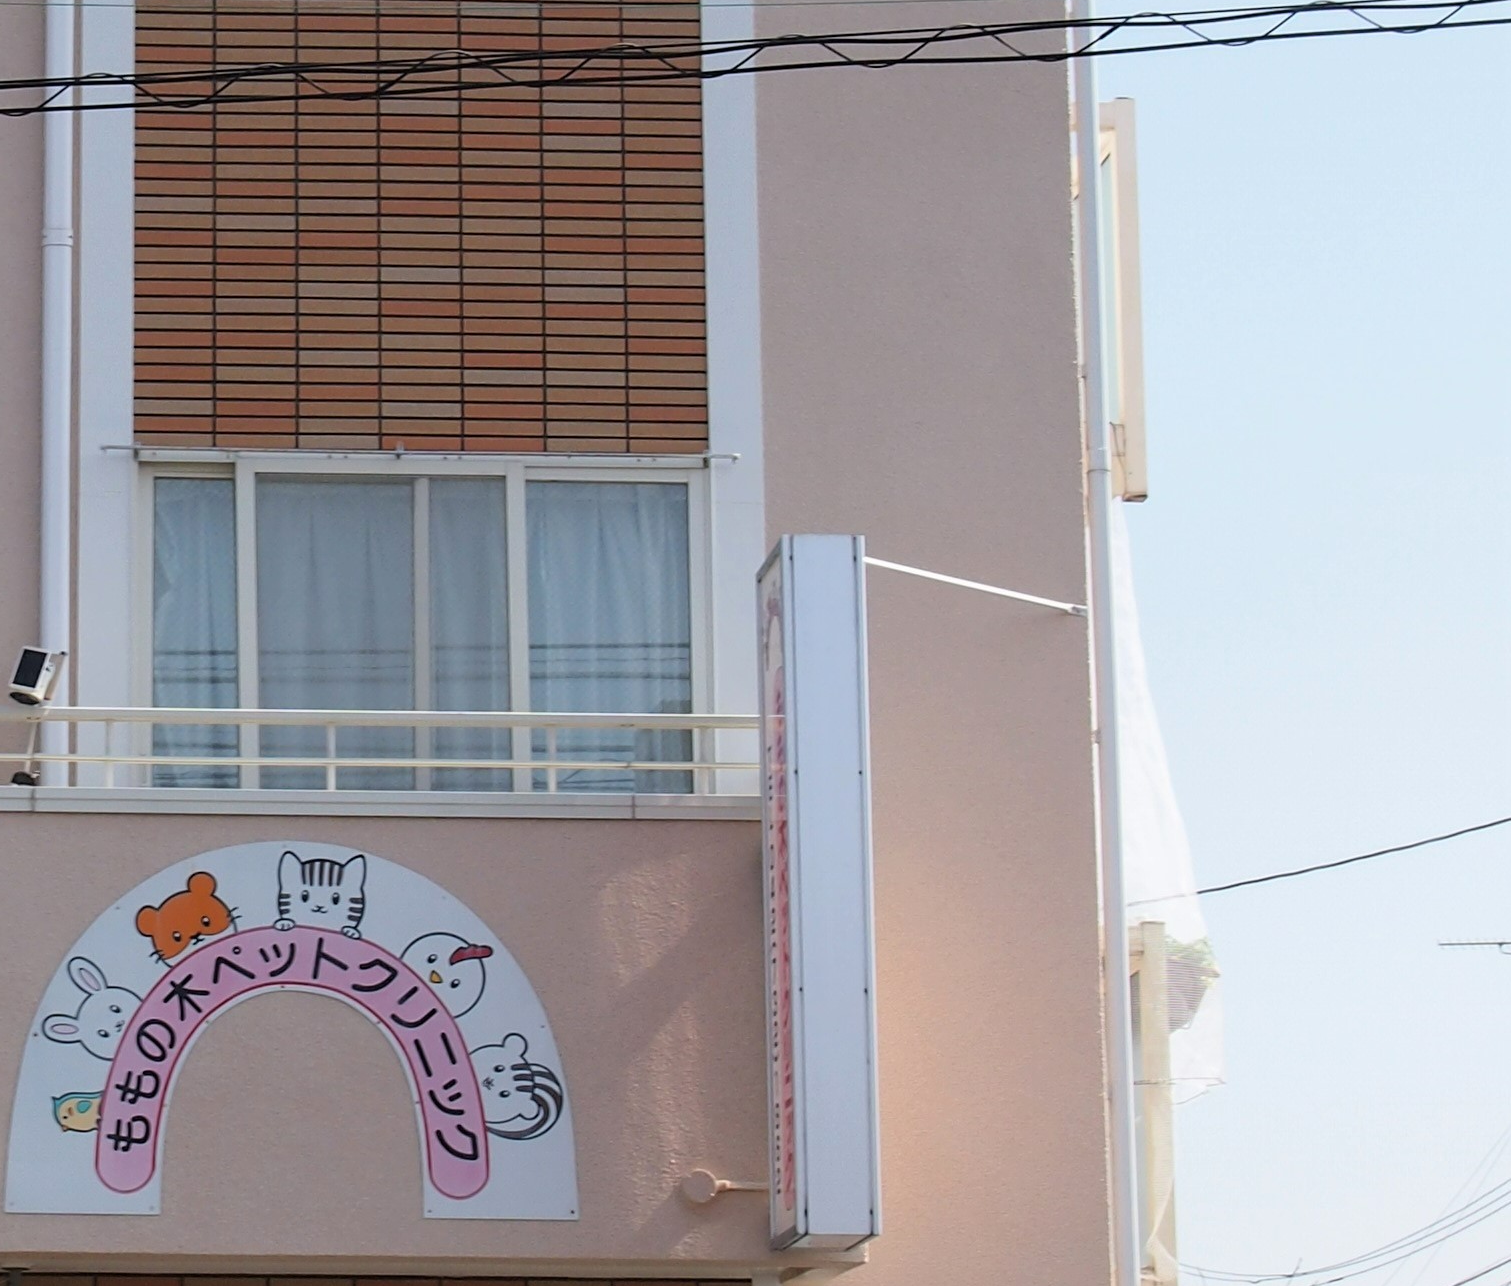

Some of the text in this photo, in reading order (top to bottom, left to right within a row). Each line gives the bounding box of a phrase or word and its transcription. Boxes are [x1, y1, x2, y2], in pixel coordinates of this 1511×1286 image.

[106, 936, 479, 1161] ももの木ペットクリニック
